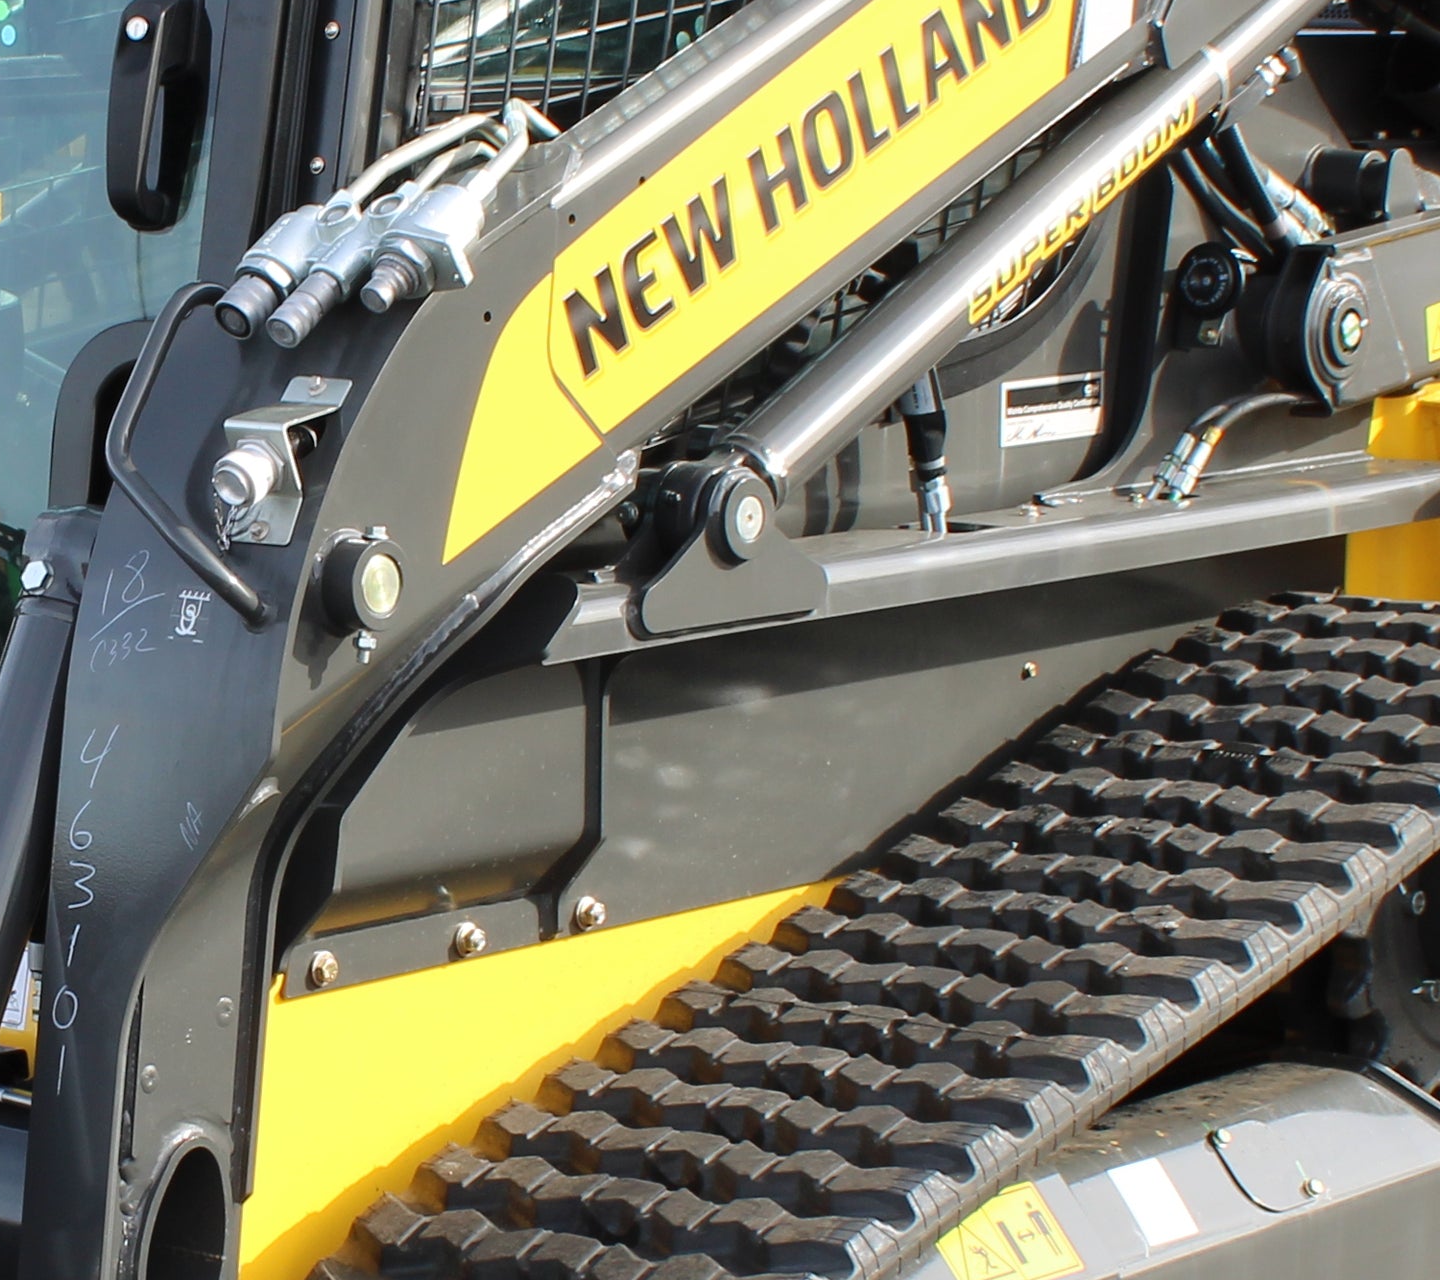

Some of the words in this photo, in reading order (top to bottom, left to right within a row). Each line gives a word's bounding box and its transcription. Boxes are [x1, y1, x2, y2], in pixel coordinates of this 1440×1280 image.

[561, 175, 738, 379] NEW
[970, 196, 1089, 318] SUPER
[1094, 96, 1195, 209] BOOM
